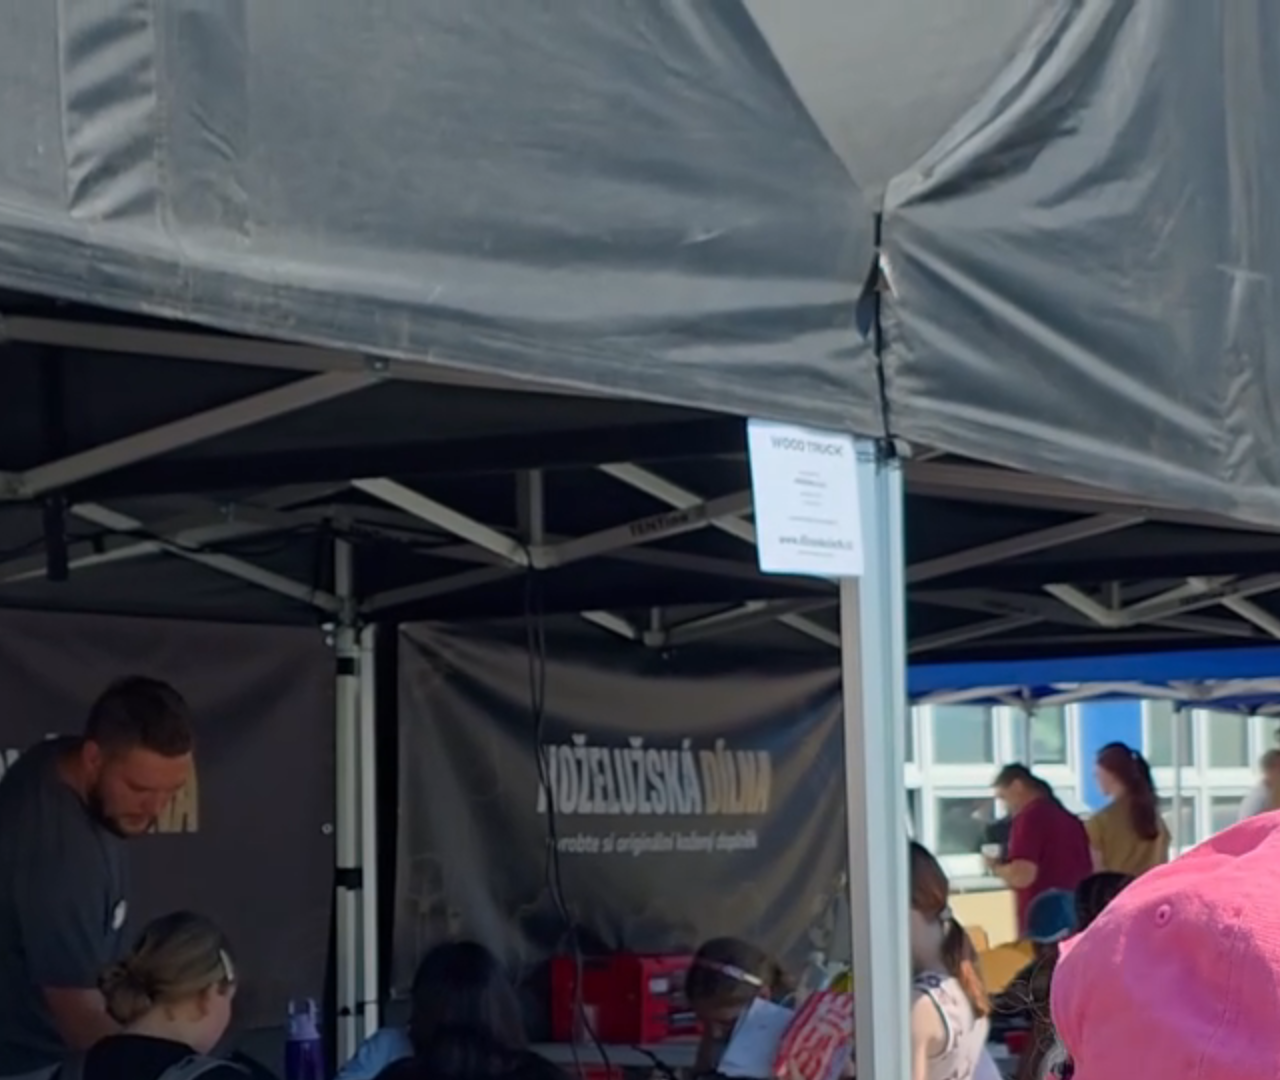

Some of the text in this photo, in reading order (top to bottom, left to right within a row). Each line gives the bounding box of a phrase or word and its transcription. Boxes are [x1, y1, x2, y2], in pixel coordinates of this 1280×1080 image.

[770, 436, 844, 458] WOOD TRUCK
[700, 738, 771, 815] DÍLNA
